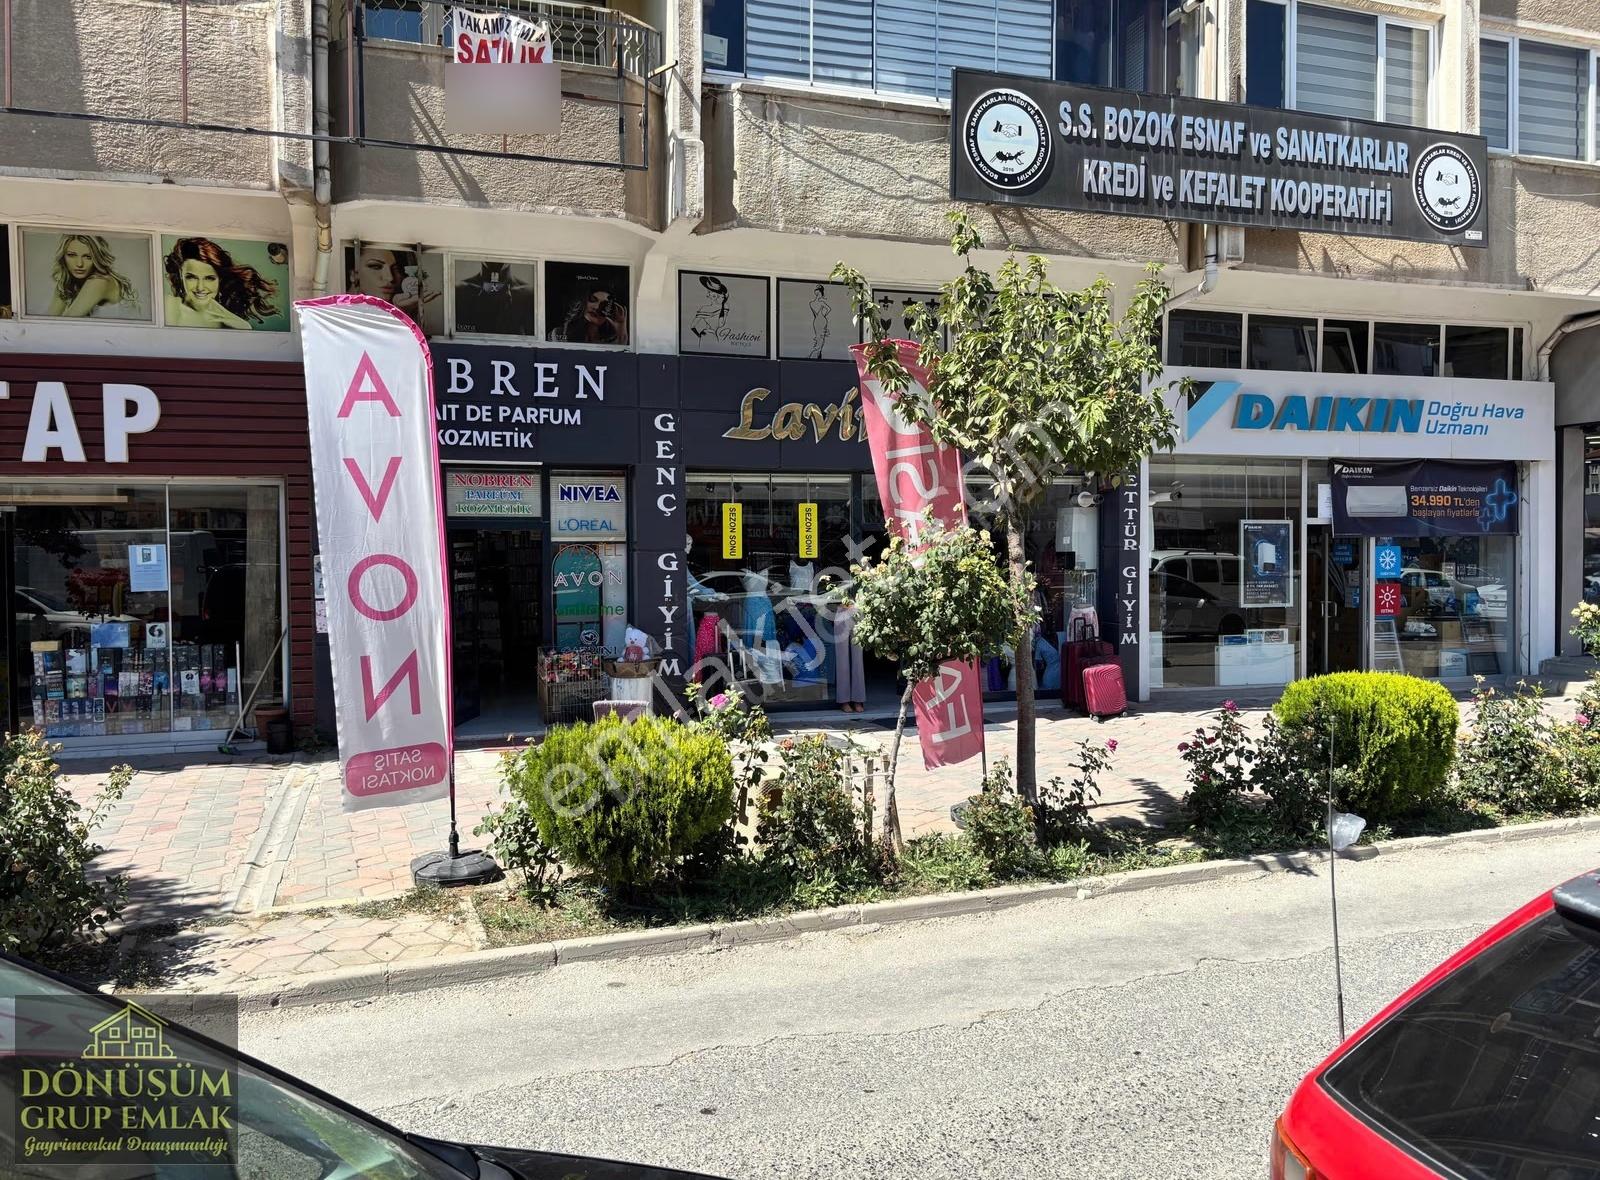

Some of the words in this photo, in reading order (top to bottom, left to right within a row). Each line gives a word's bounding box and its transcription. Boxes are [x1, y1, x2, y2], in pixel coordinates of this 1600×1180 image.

[1059, 101, 1097, 138] S.S.
[1104, 106, 1176, 148] BOZOK
[1181, 115, 1245, 155] ESNAF
[1250, 132, 1271, 158] ve
[1276, 127, 1409, 174] SANATKARLAR
[1083, 156, 1145, 198] KREDİ
[1152, 174, 1173, 201] ve
[1180, 169, 1265, 209] KEFALET
[1271, 178, 1392, 221] KOOPERATİFİ
[718, 327, 762, 343] Fashion
[447, 358, 608, 401] BREN
[466, 404, 492, 422] DE
[499, 408, 581, 425] PARFUM
[1232, 393, 1425, 433] DAIKIN
[1427, 401, 1477, 422] Doğru
[1483, 403, 1524, 419] Hava
[1425, 419, 1489, 436] Uzmanı
[654, 413, 677, 517] GENÇ
[1342, 466, 1373, 474] DAIKIN
[454, 474, 533, 487] NOBREN
[465, 488, 523, 501] PARFÜM
[559, 484, 621, 503] NIVEA
[1411, 495, 1451, 506] 34.990
[1121, 459, 1140, 551] ETTÜR
[1412, 508, 1446, 518] başlayan
[1447, 508, 1480, 518] fiyatlarla
[729, 507, 737, 533] SEZON
[729, 536, 737, 557] SONU
[554, 571, 622, 587] AVON
[656, 552, 682, 677] GİYİM
[1120, 566, 1139, 645] GİYİM
